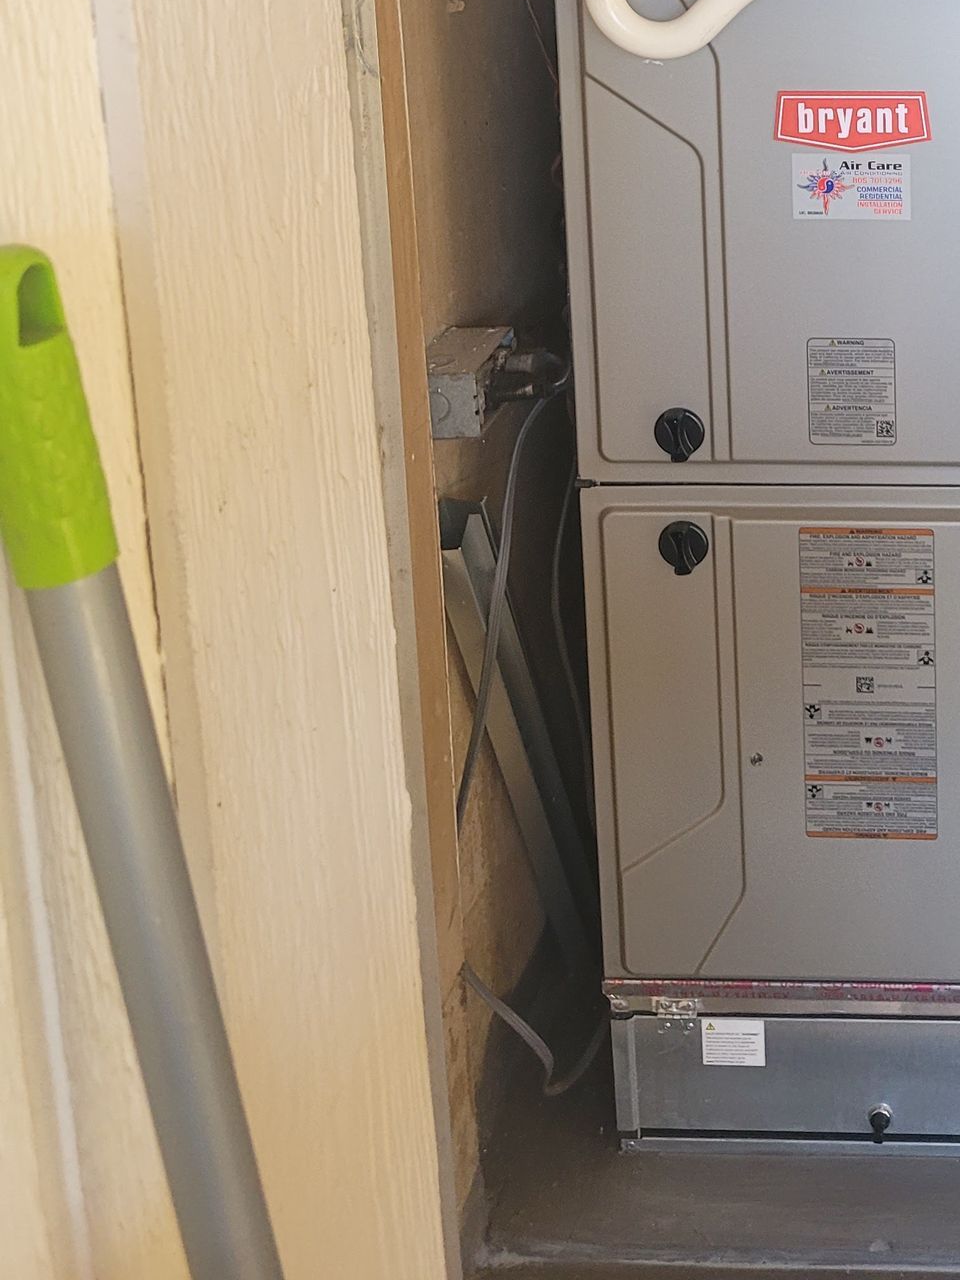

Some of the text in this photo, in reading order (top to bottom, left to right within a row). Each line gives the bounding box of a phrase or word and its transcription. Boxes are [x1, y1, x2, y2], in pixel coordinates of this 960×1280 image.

[798, 102, 908, 139] bryant
[839, 161, 902, 170] Air Care
